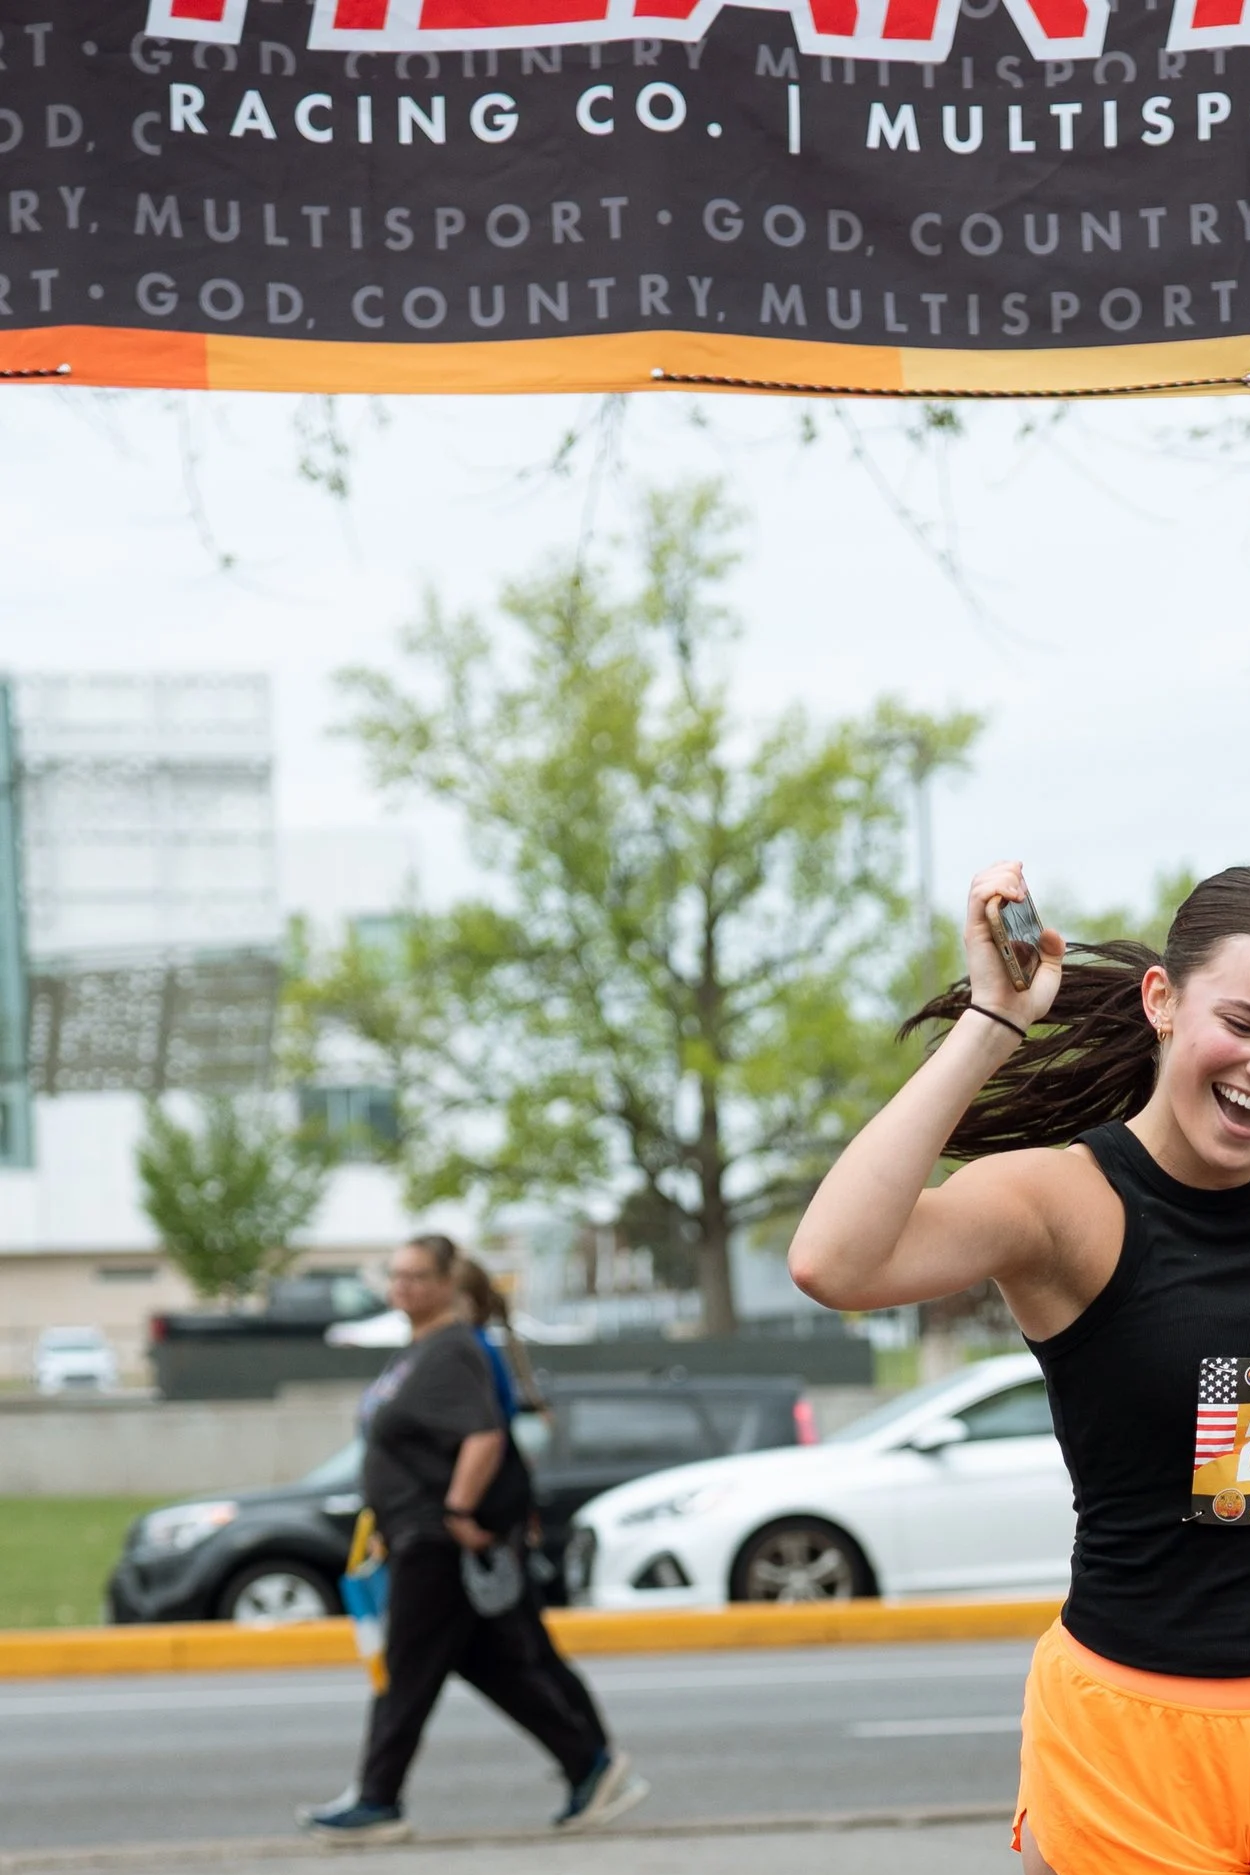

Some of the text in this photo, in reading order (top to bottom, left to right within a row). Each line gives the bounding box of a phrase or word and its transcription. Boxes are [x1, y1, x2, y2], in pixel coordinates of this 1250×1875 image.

[169, 82, 519, 145] RACING
[575, 81, 723, 138] CO.
[9, 186, 99, 234] RY,
[134, 192, 629, 251] MULTISPORT
[703, 198, 875, 257] GOD,
[136, 271, 315, 329] GOD,
[351, 274, 726, 329] COUNTRY,
[760, 280, 1239, 336] MULTISPORT
